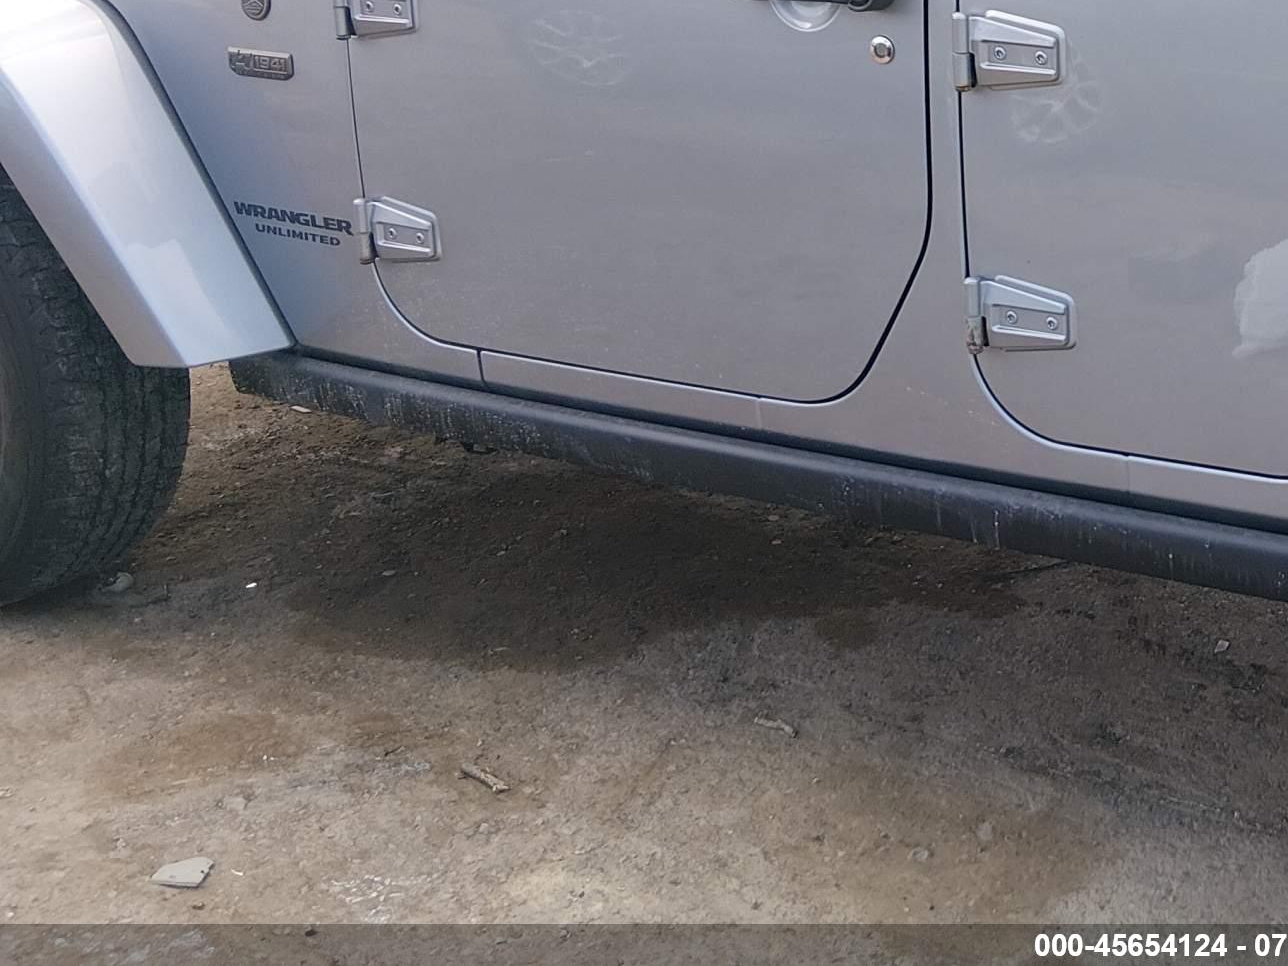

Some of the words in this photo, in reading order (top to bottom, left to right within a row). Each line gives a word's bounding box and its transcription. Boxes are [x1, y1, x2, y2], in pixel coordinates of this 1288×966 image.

[254, 55, 286, 71] 1941
[234, 201, 353, 235] WRANGLER
[255, 223, 341, 246] UNLIMITED
